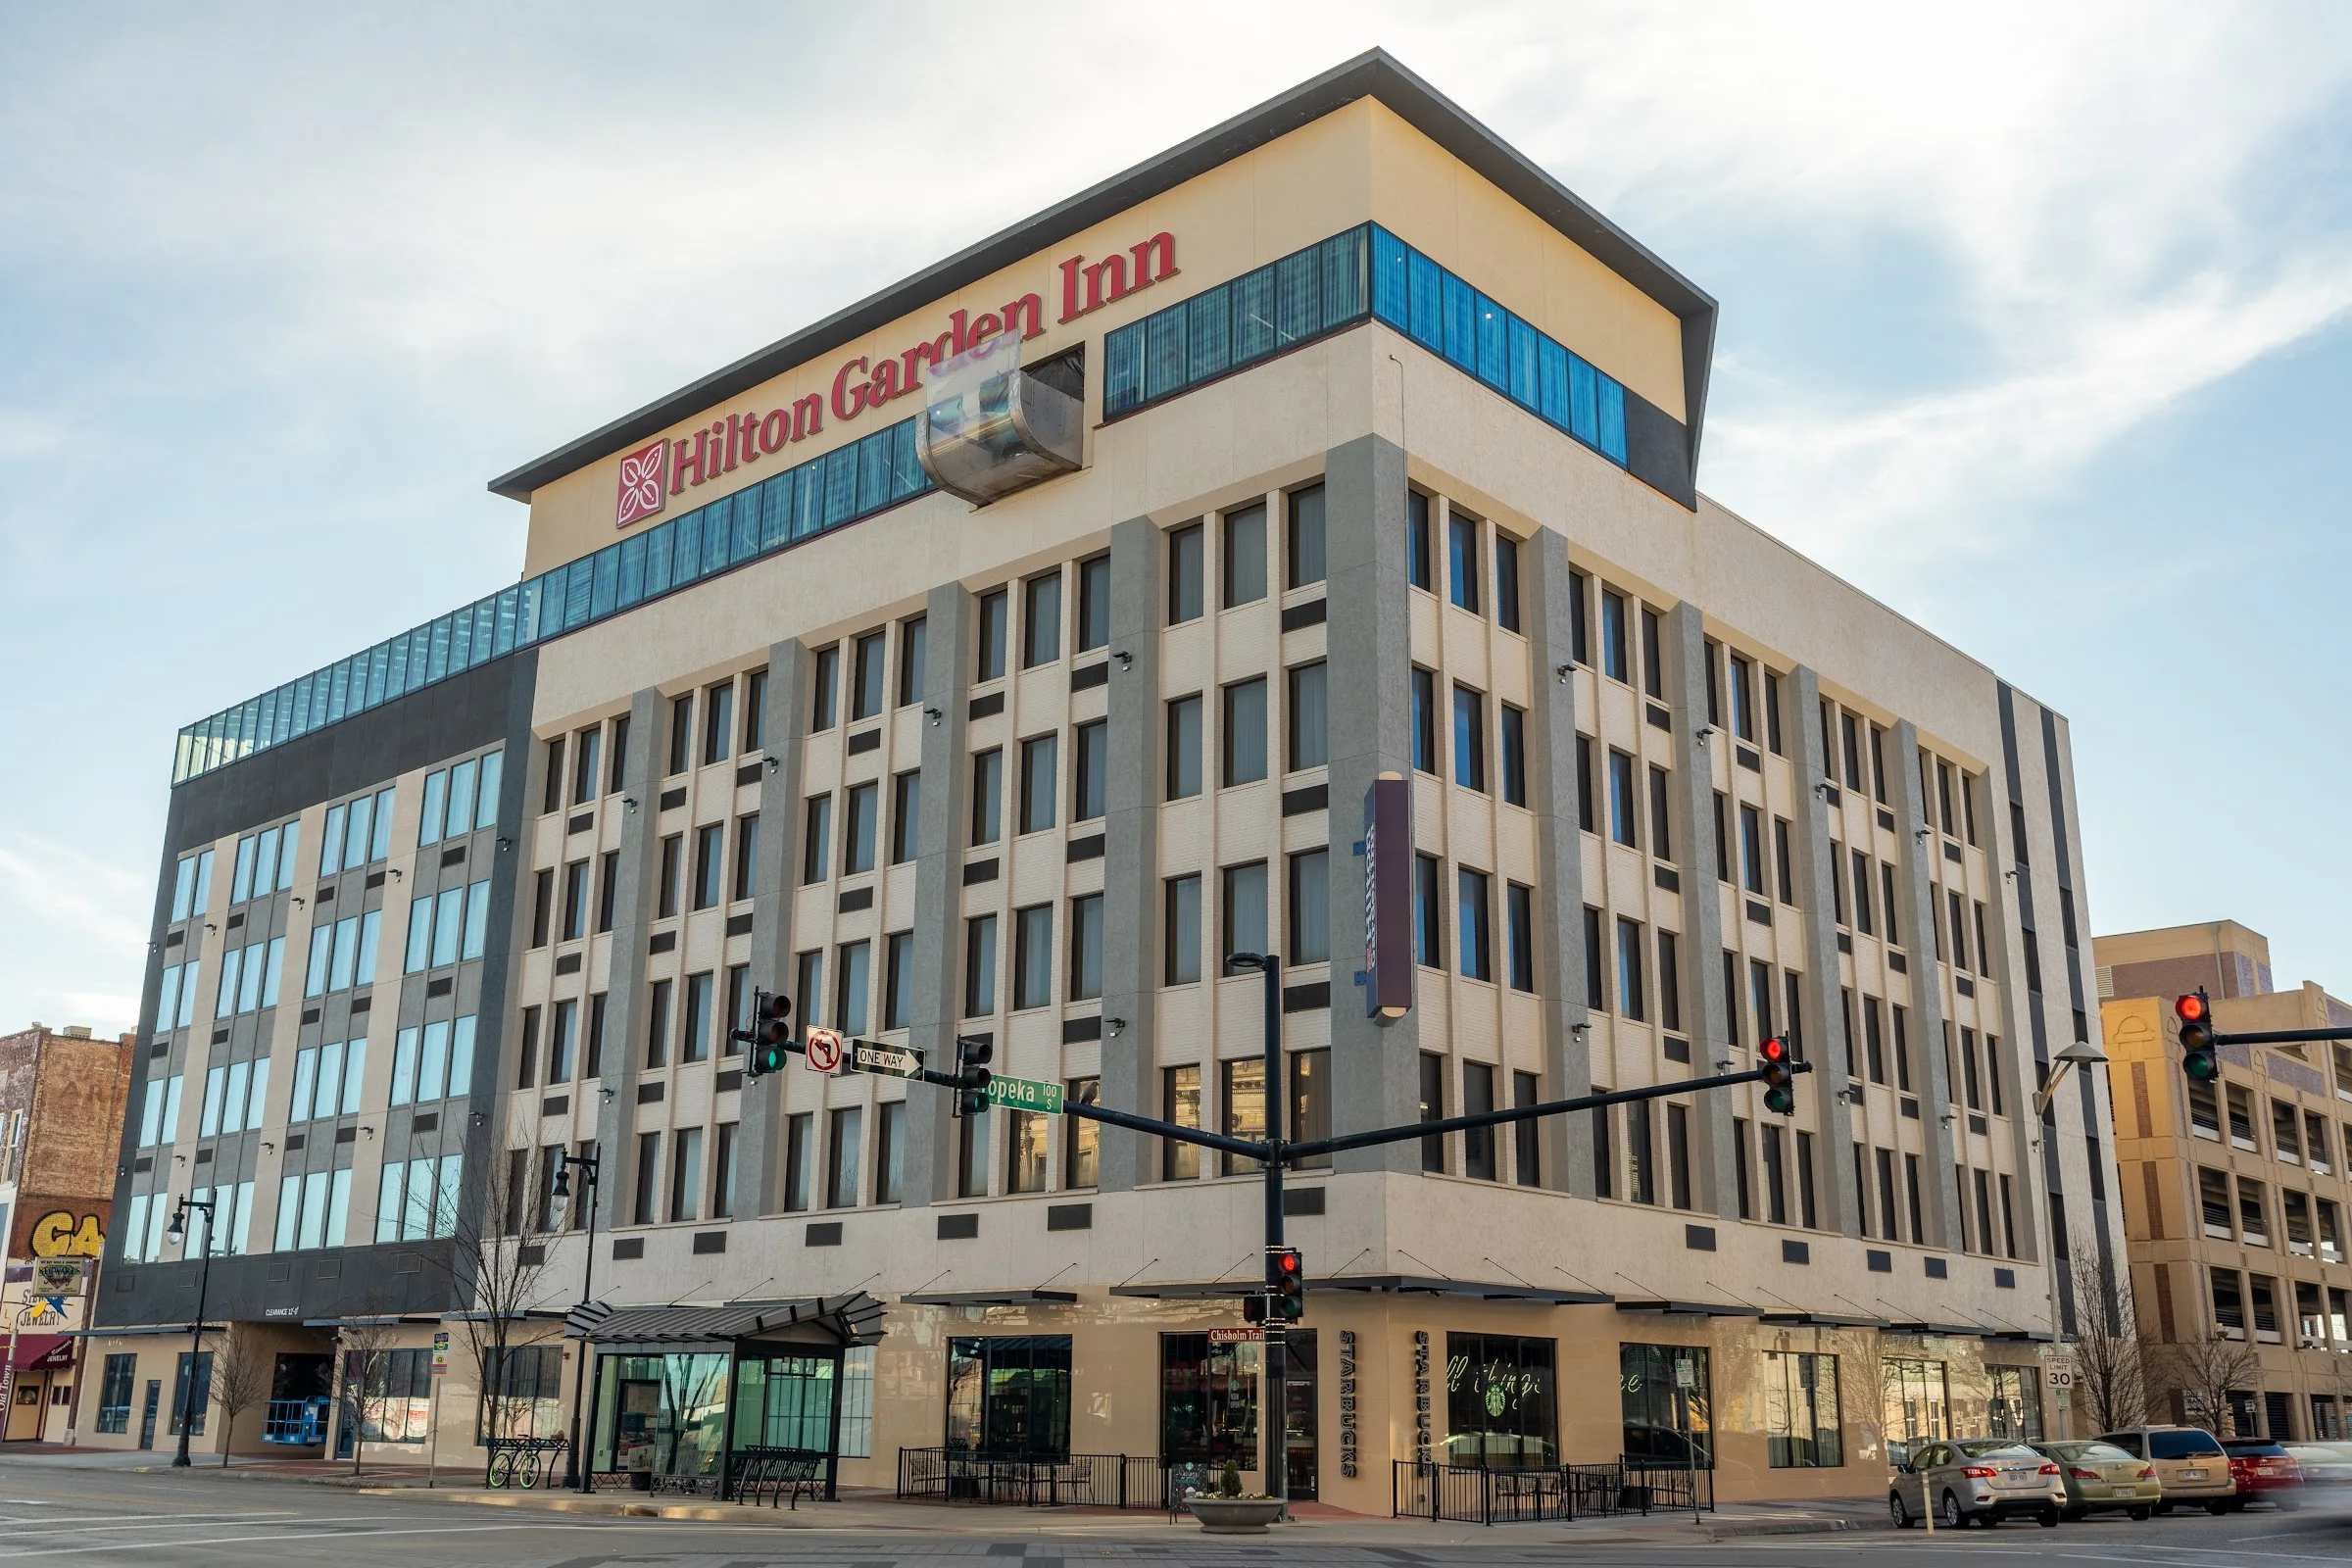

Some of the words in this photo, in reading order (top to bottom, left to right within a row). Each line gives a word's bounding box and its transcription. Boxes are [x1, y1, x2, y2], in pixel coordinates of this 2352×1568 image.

[668, 391, 824, 495] Hilton
[831, 292, 1047, 421] Garden
[1057, 231, 1181, 325] Inn
[859, 1050, 880, 1064] ONE
[883, 1054, 904, 1068] WAY
[981, 1079, 1035, 1104] opeka
[1043, 1083, 1057, 1098] 100
[1046, 1098, 1053, 1110] S
[1210, 1329, 1247, 1341] Chisholm
[1247, 1329, 1265, 1341] Trail
[46, 1354, 69, 1363] JEWELRY
[0, 1364, 12, 1391] Town
[2049, 1372, 2071, 1385] 30
[1340, 1330, 1356, 1478] STARBUCKS
[1415, 1330, 1431, 1478] STARBUCKS
